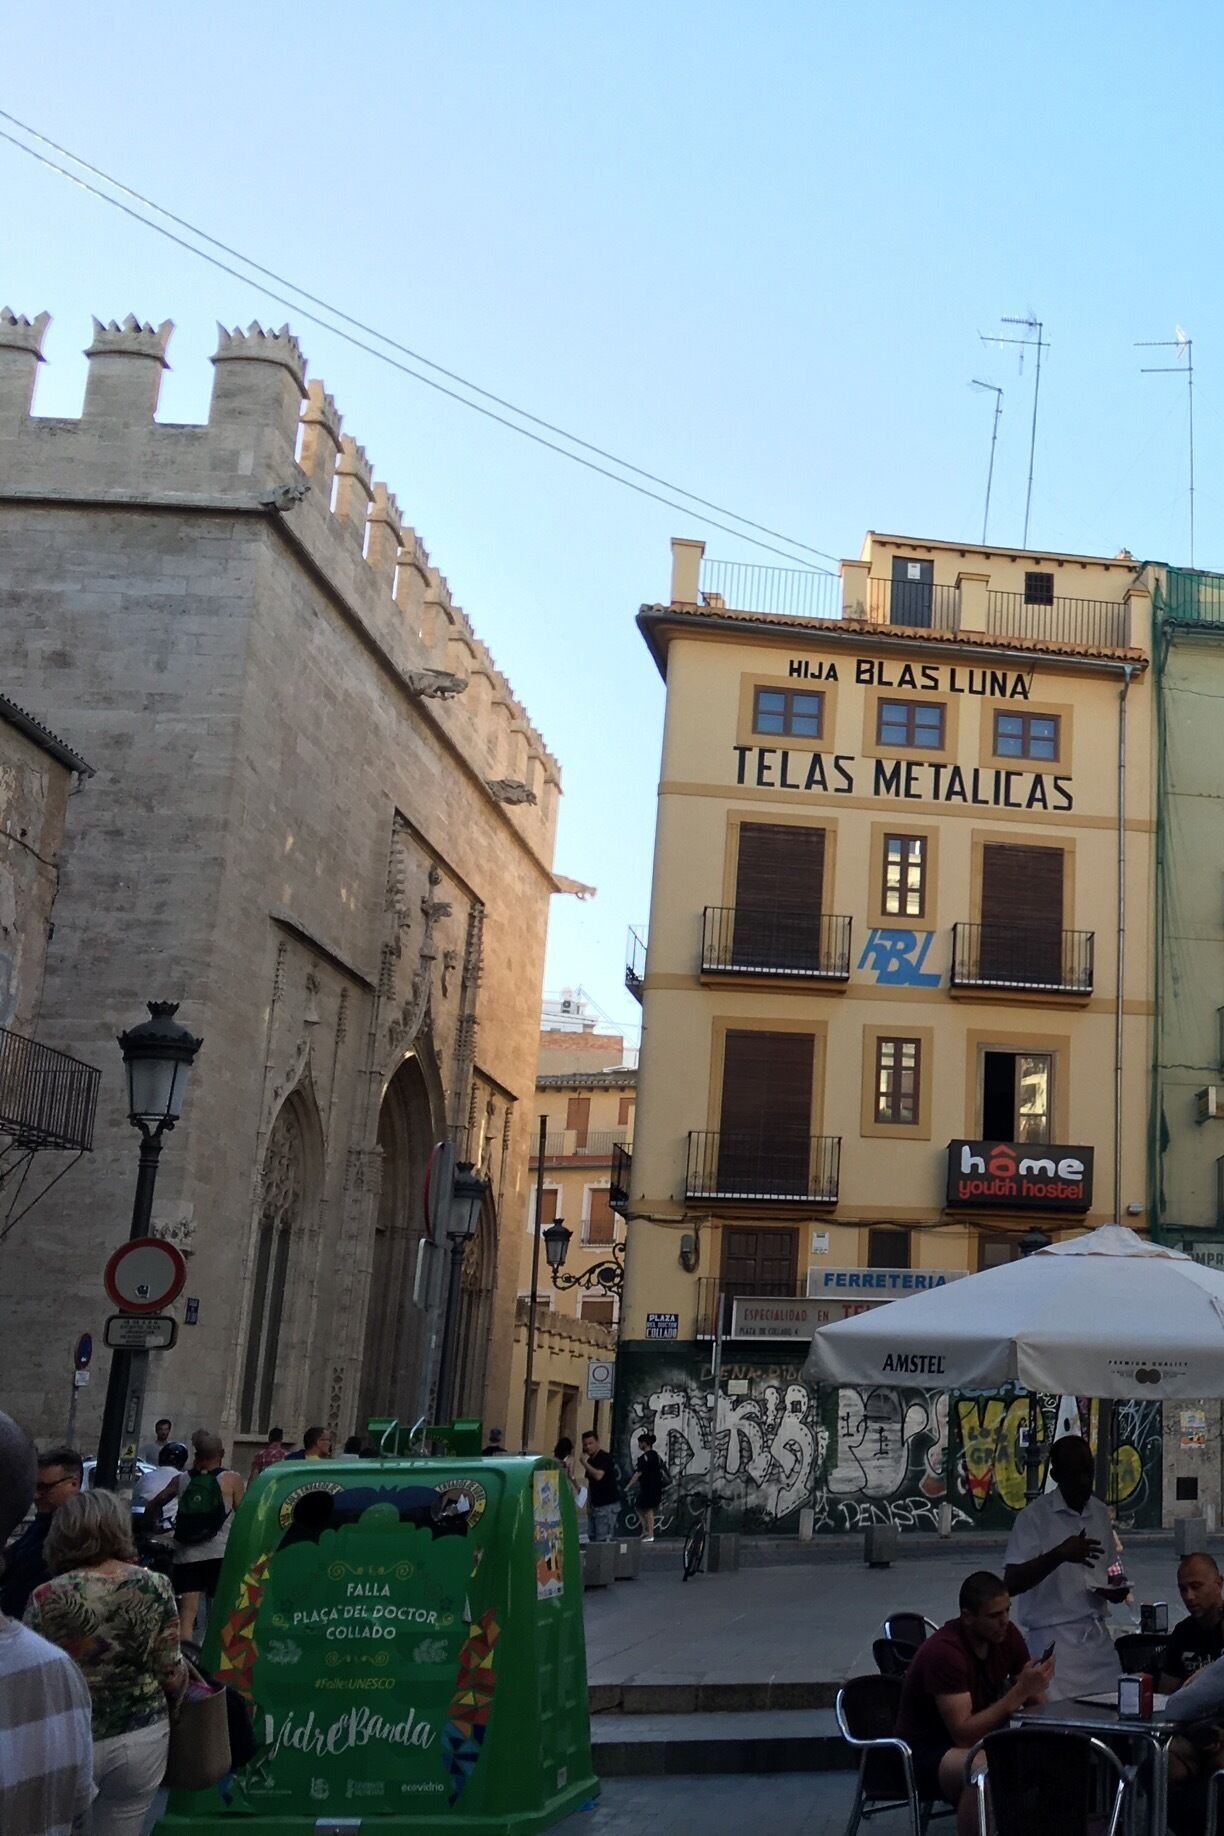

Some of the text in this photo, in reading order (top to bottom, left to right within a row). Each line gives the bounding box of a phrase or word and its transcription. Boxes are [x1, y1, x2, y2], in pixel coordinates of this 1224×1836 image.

[788, 658, 1030, 700] HIJA BLAS LUNA
[733, 745, 1073, 812] TELAS METALICAS
[958, 1179, 1084, 1199] youth hostel
[823, 1272, 947, 1289] FERRETERIA
[648, 1314, 676, 1322] PLAZA
[744, 1308, 807, 1322] ESPECIALIDAD
[817, 1310, 829, 1322] EN
[646, 1328, 678, 1339] COLLADO
[882, 1354, 946, 1374] AMSTEL
[346, 1582, 390, 1597] FALLA
[293, 1605, 438, 1625] PLAÇA DEL DOCTOR
[326, 1625, 396, 1640] COLLADO
[401, 1781, 445, 1792] ecovidrio
